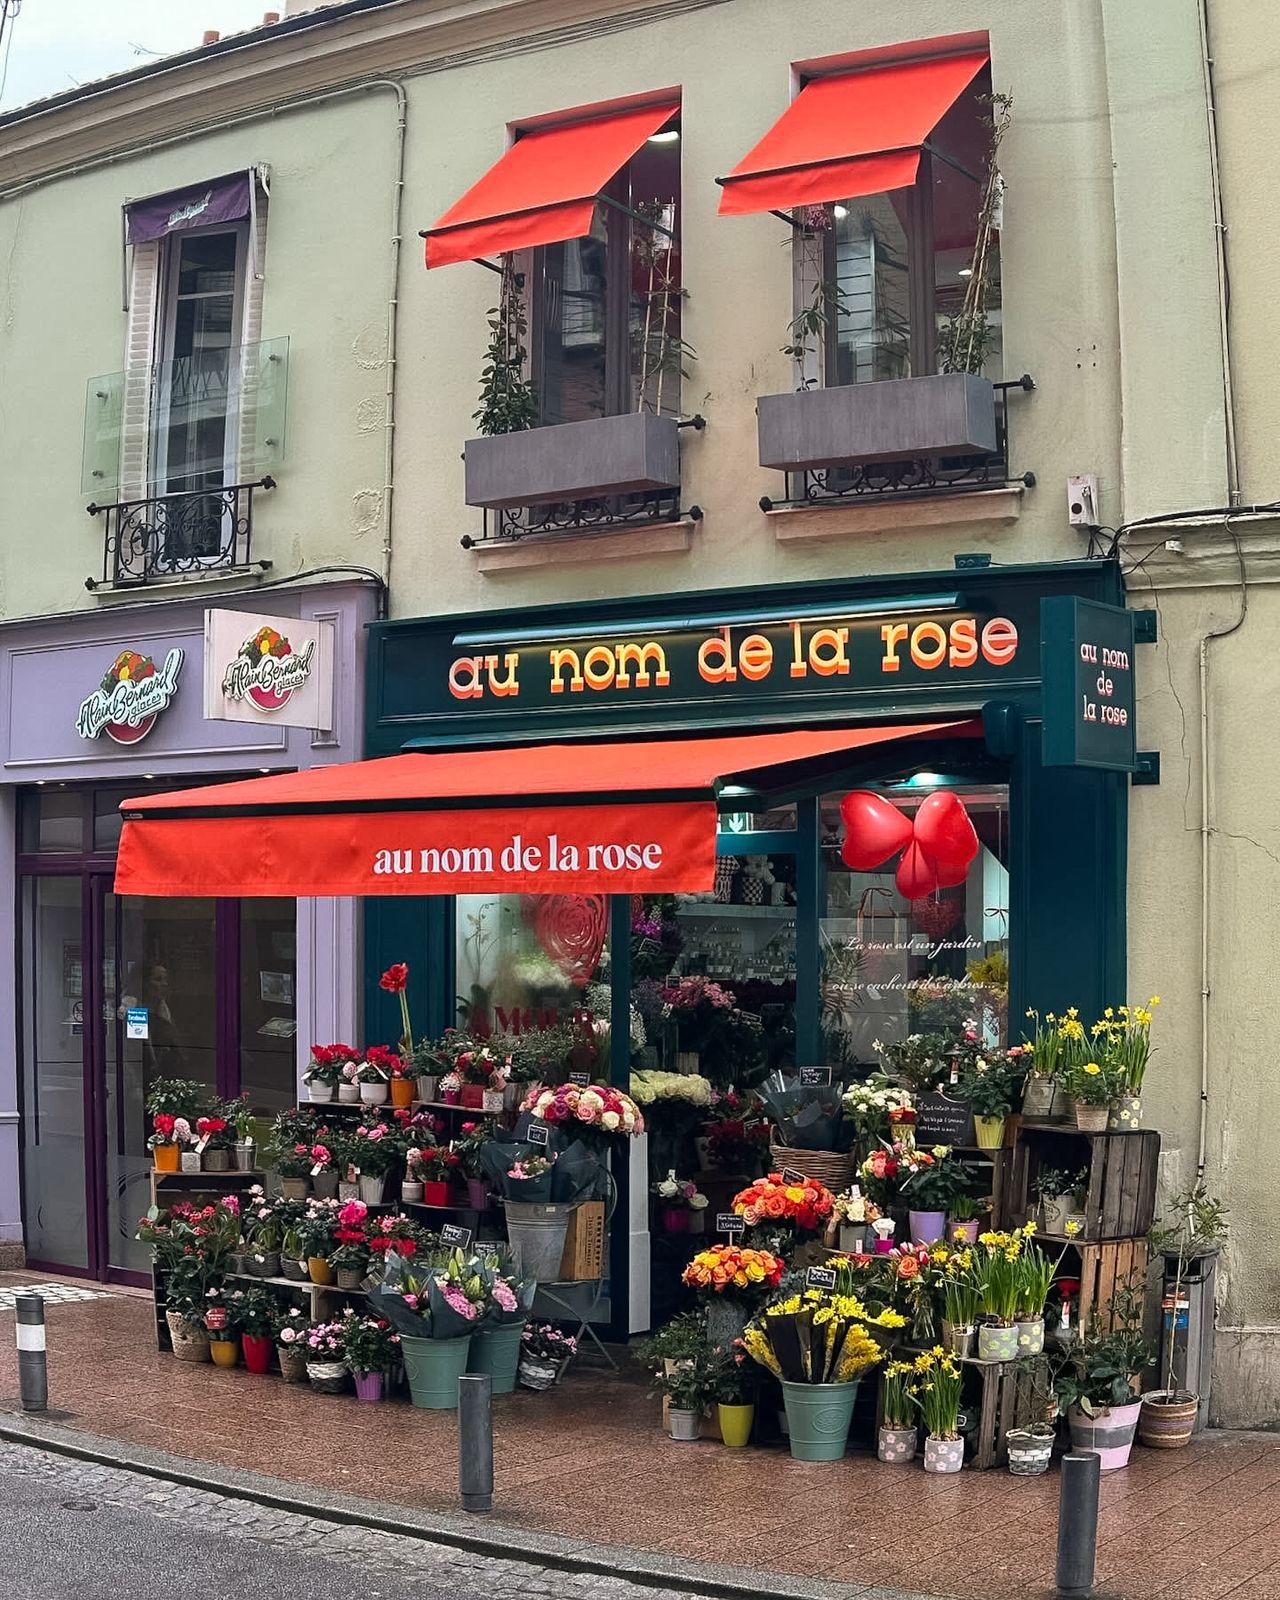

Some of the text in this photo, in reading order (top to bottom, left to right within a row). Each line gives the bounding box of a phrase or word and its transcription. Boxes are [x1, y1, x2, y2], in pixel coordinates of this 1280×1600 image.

[449, 617, 1018, 699] au nom de la rose
[1080, 643, 1130, 670] au nom
[276, 673, 304, 696] glaces
[1096, 670, 1113, 696] de
[128, 693, 163, 724] glaces
[1083, 694, 1128, 726] la rose
[373, 833, 663, 874] au nom de la rose
[842, 934, 982, 960] La rose est un jardin
